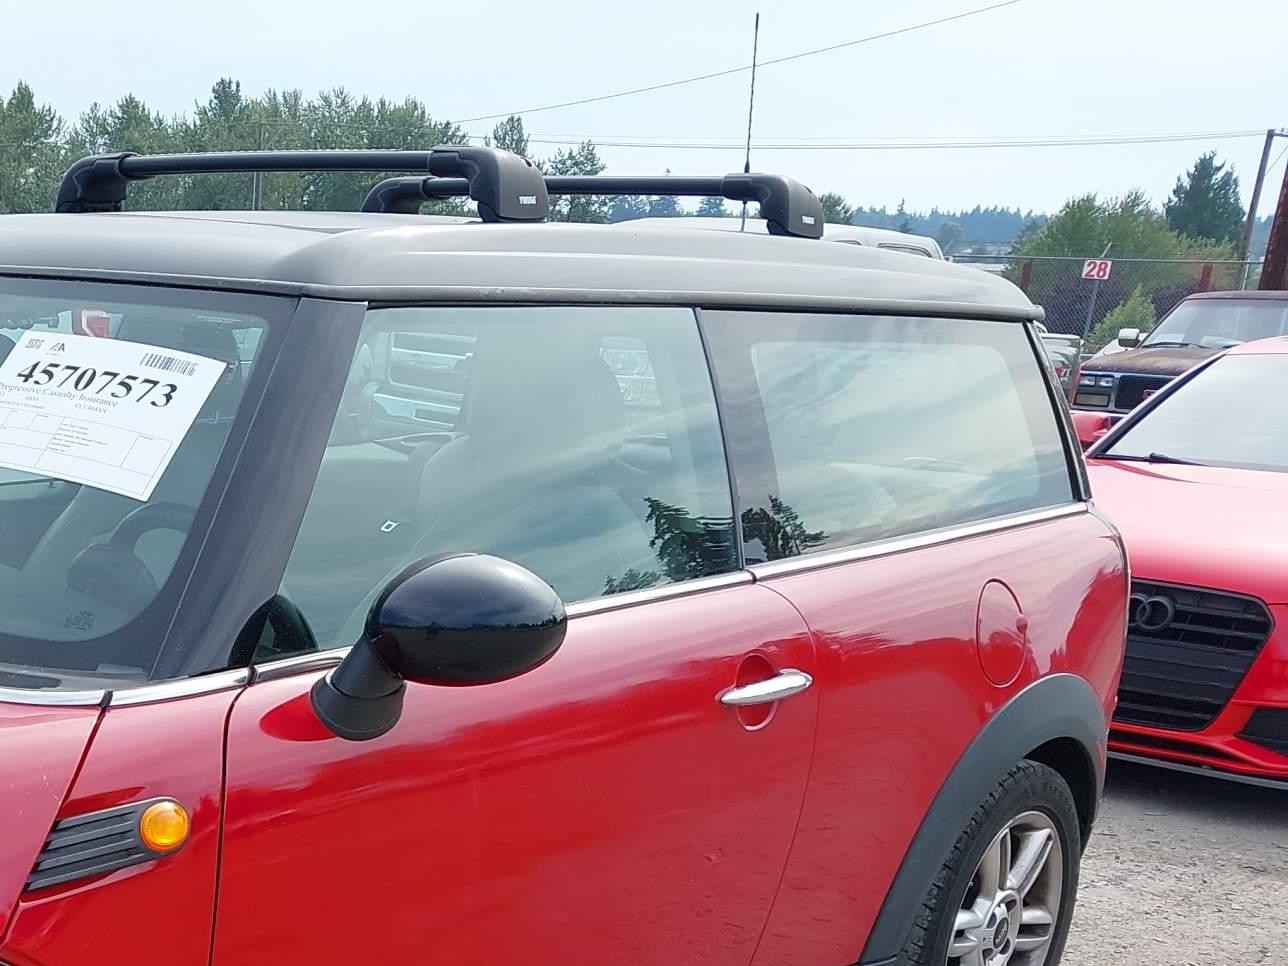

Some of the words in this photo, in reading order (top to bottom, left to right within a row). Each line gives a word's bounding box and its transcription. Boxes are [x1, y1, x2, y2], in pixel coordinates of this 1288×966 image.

[1084, 260, 1109, 279] 28
[15, 360, 178, 408] 45707573
[42, 387, 77, 401] Casualty
[78, 393, 119, 408] Insurance
[74, 402, 107, 414] CLUBMAN
